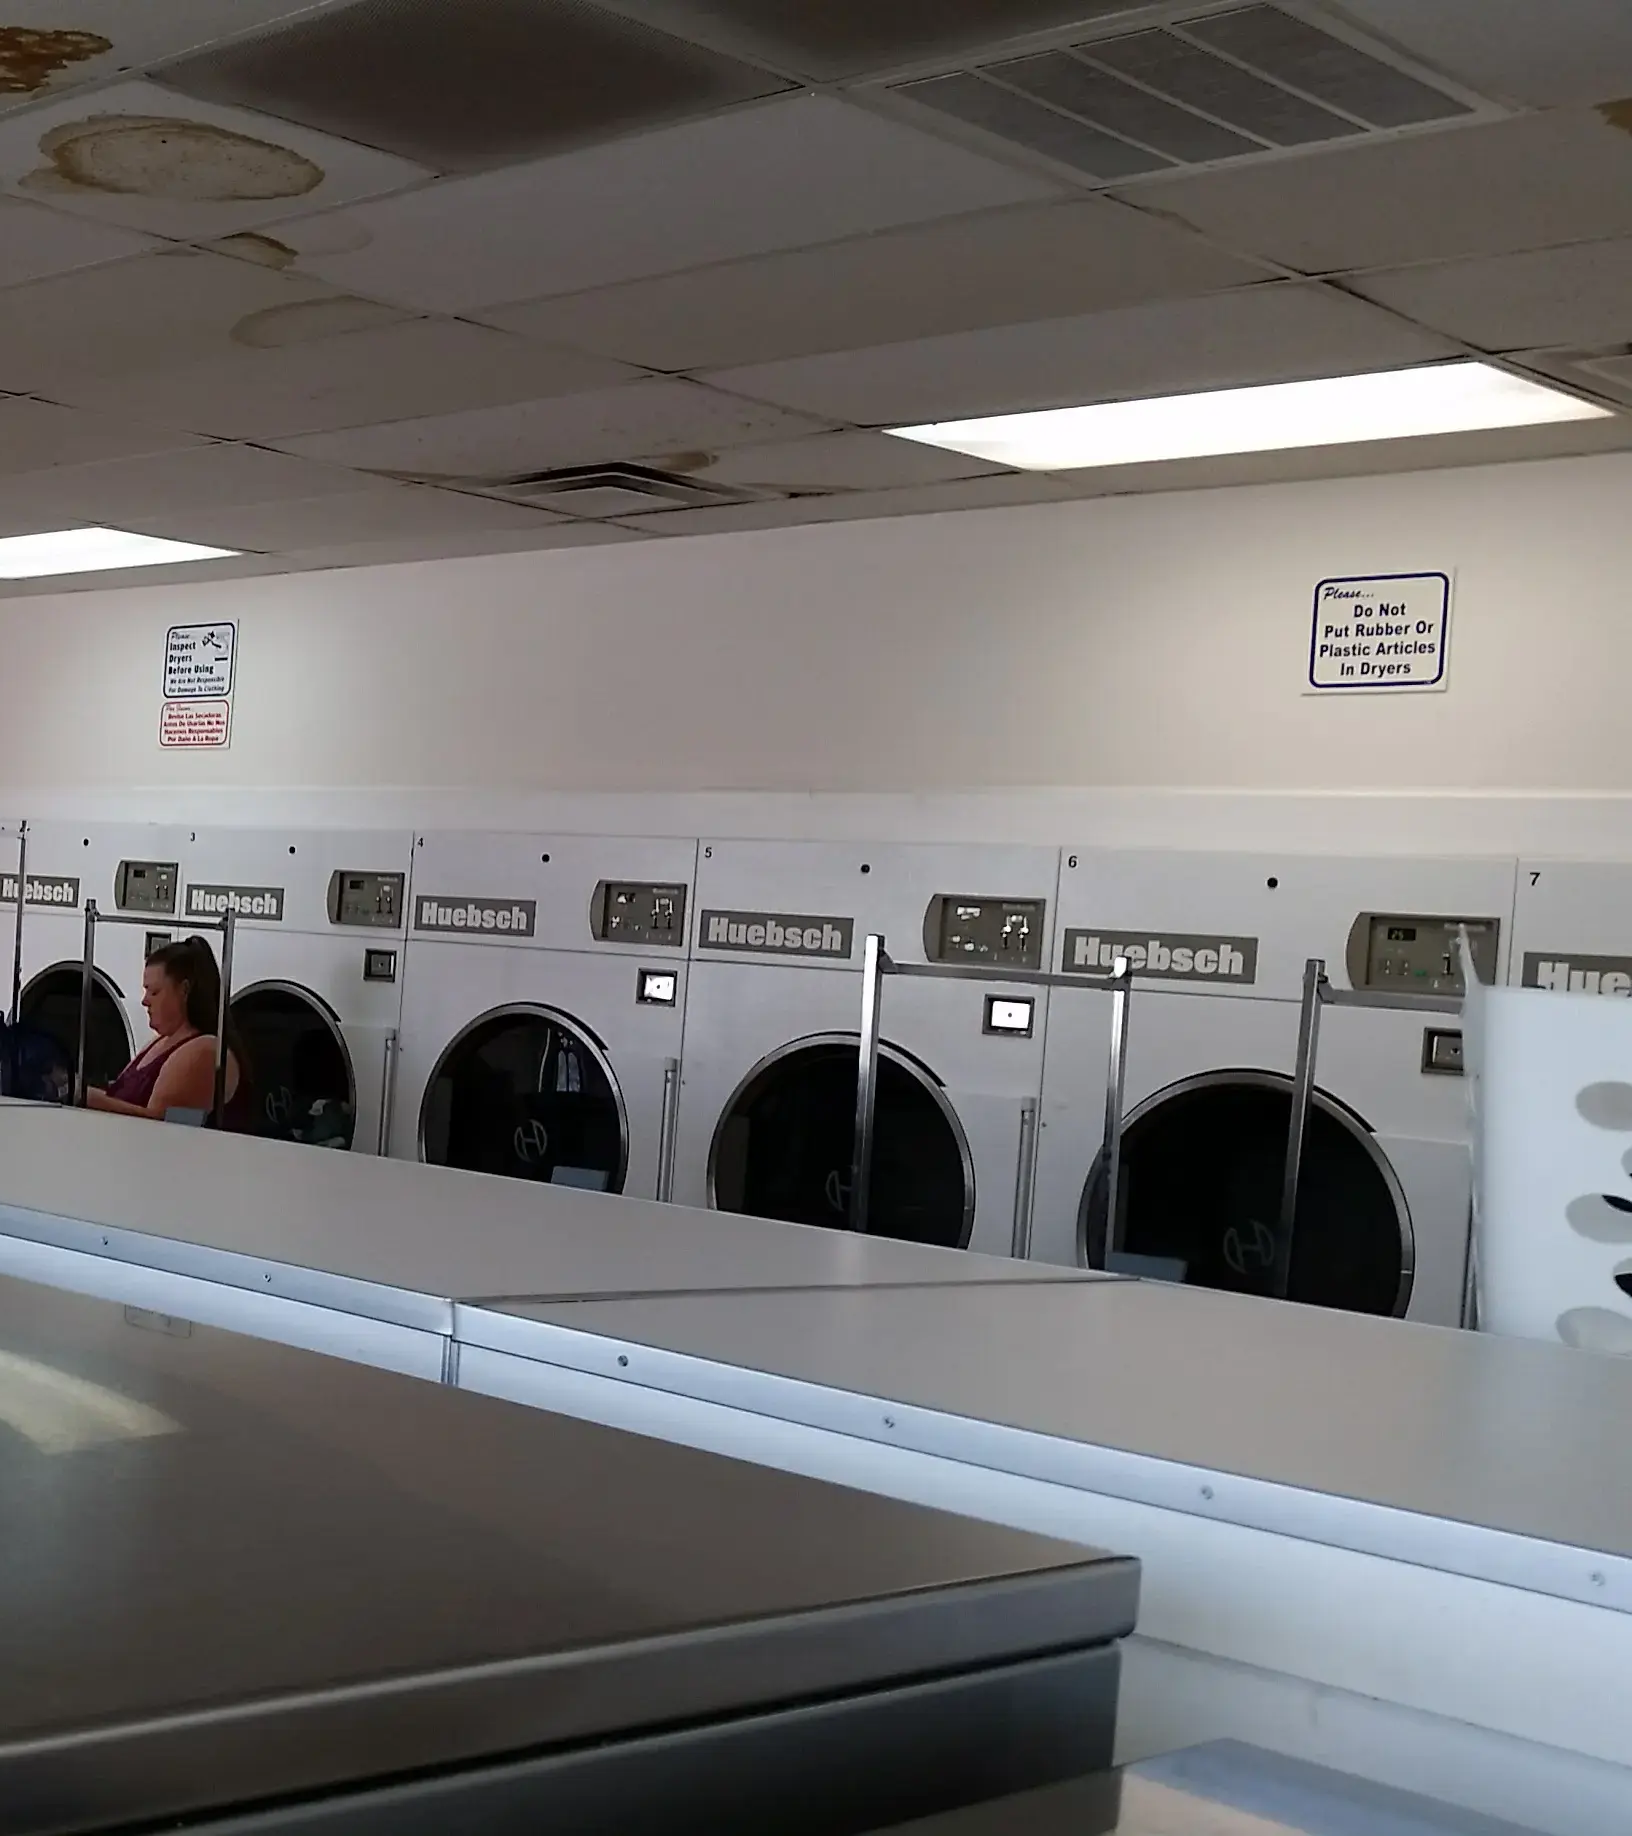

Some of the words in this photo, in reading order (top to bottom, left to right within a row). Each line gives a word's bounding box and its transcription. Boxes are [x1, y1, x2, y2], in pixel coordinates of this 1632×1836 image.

[1353, 604, 1374, 619] Do
[1378, 602, 1407, 617] Not
[1324, 624, 1350, 638] Put
[1354, 621, 1411, 637] Rubber
[1415, 620, 1434, 634] Or
[169, 641, 197, 652] Inspect
[1319, 642, 1371, 658] Plastic
[1375, 640, 1436, 656] Articles
[168, 653, 193, 665] Dryers
[168, 665, 193, 676] Before
[194, 663, 214, 675] Using
[1340, 662, 1355, 676] In
[1360, 661, 1412, 678] Dryers
[189, 832, 197, 843] 3
[417, 837, 424, 848] 4
[704, 847, 713, 859] 5
[1067, 855, 1078, 869] 6
[1529, 871, 1541, 886] 7
[190, 888, 278, 916] Huebsch
[420, 901, 528, 930] Huebsch
[707, 916, 843, 951] Huebsch
[1073, 935, 1244, 976] Huebsch
